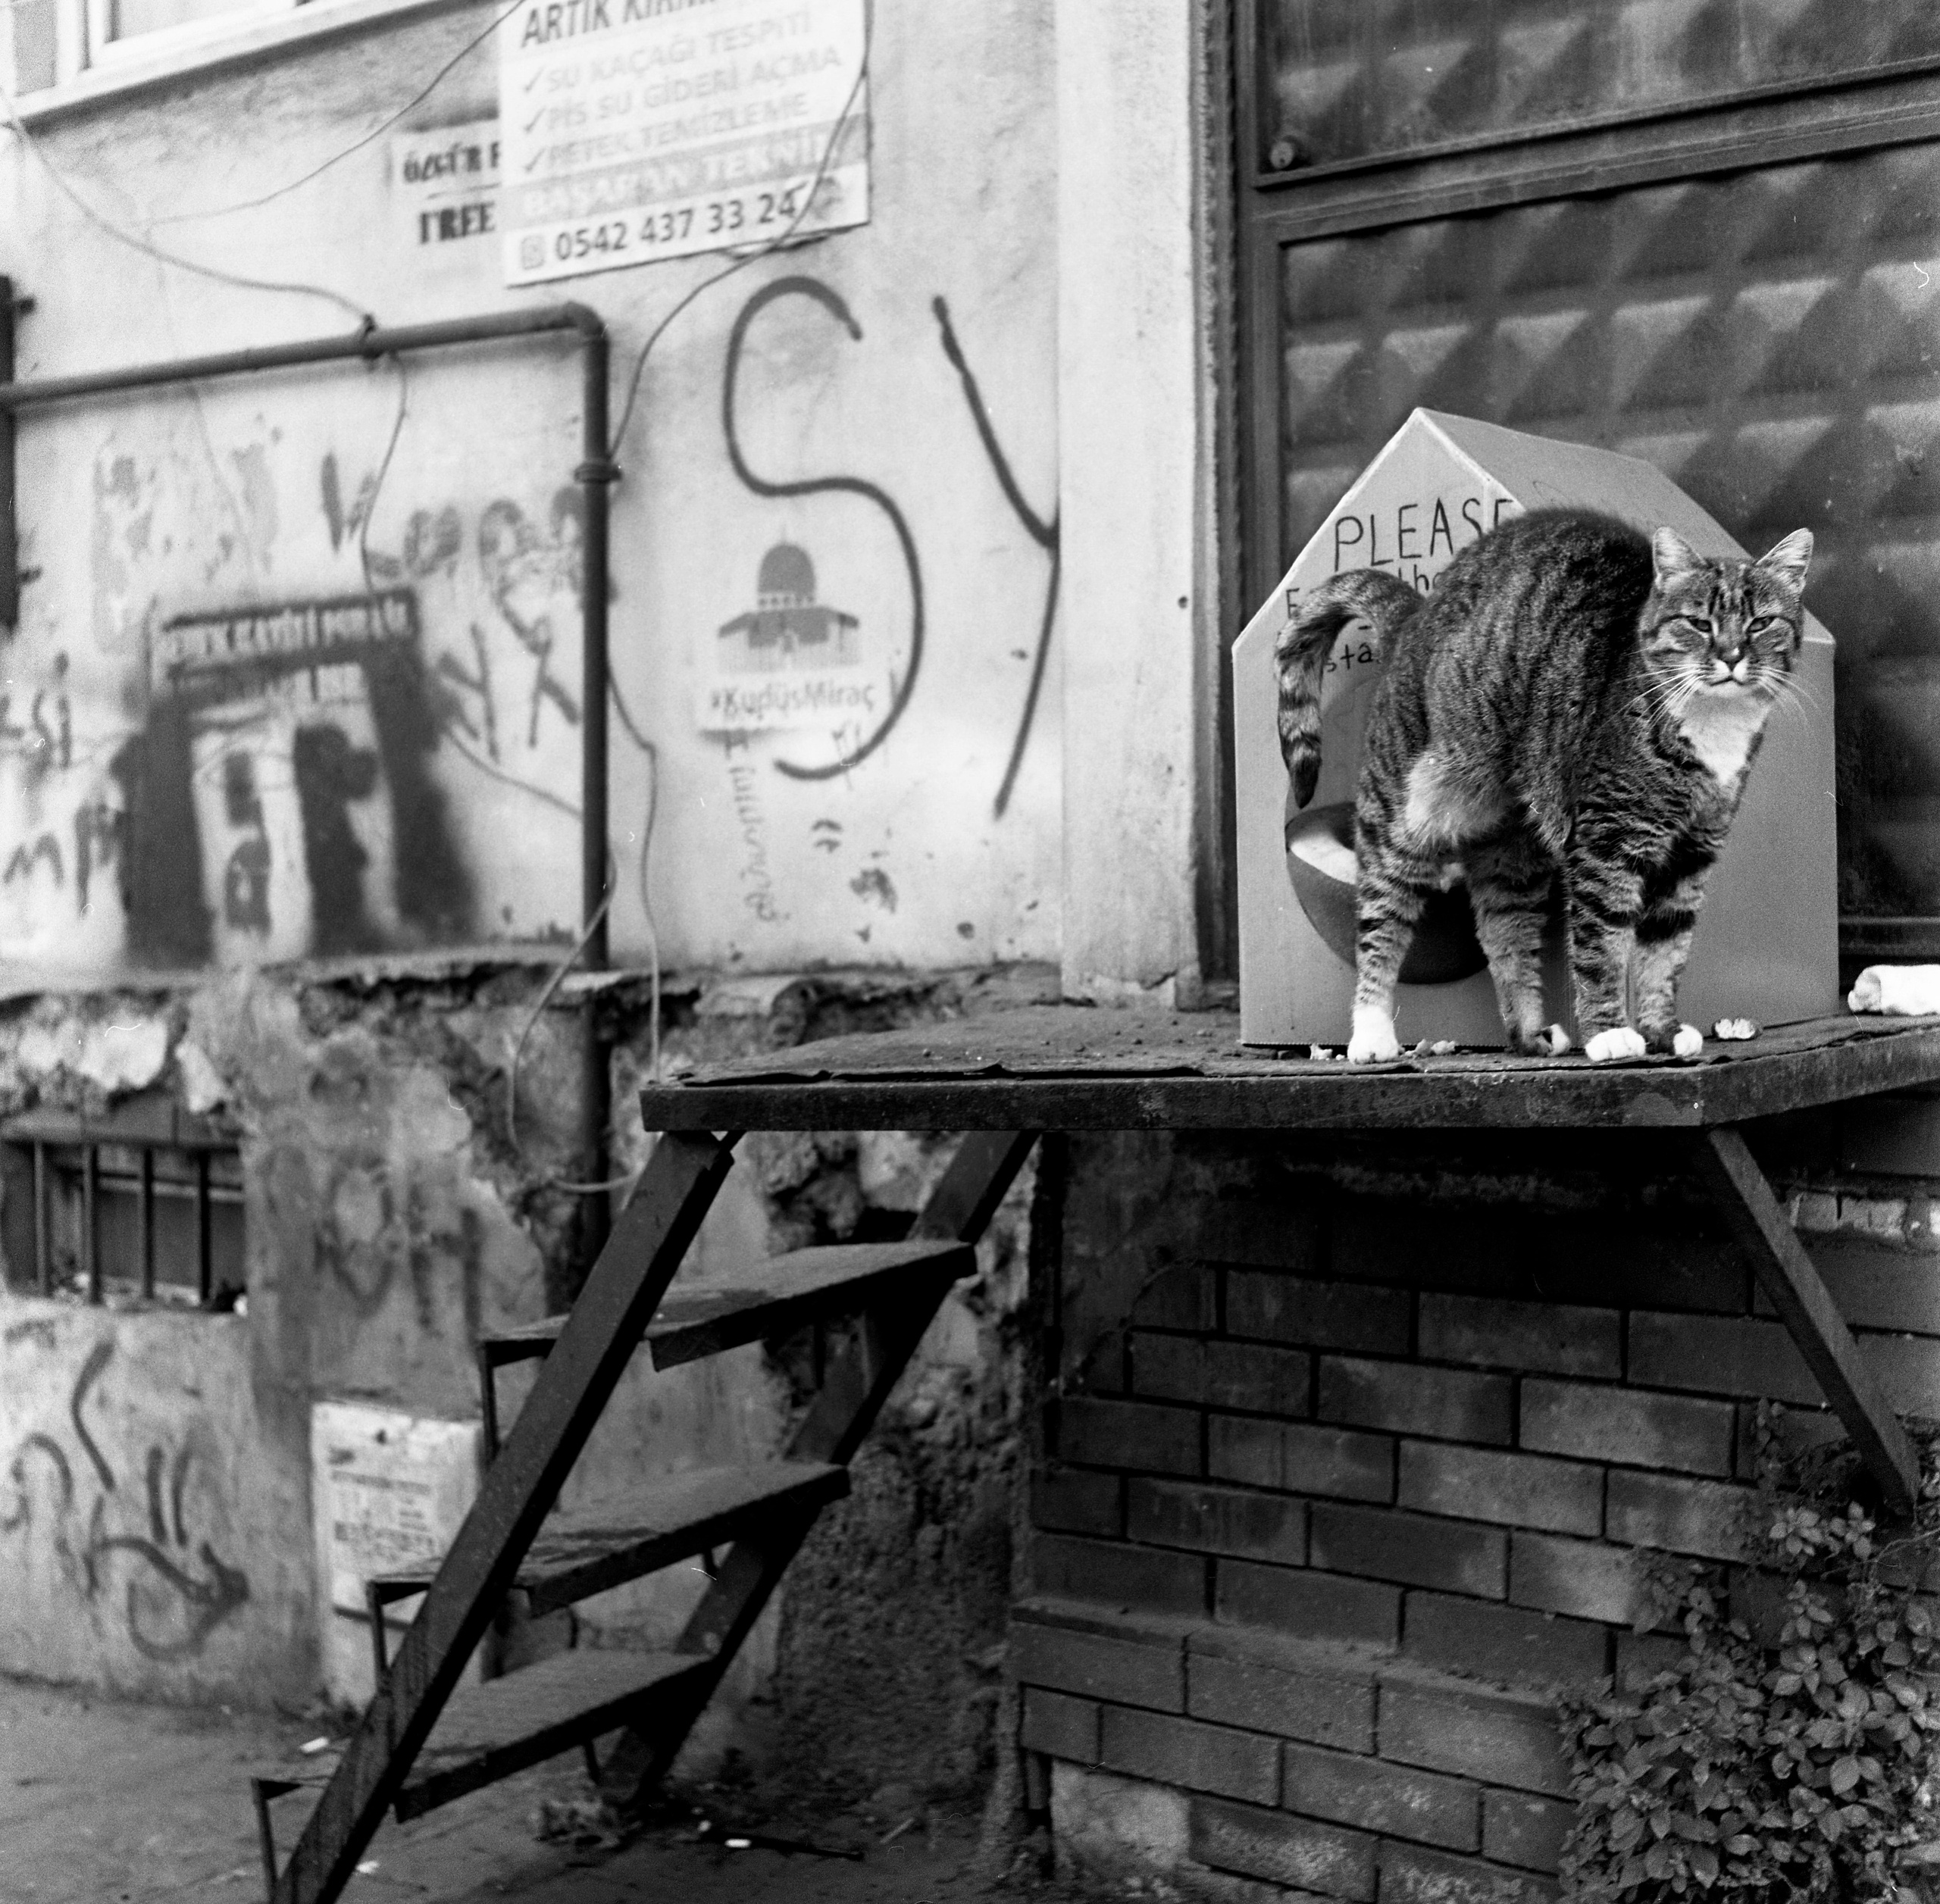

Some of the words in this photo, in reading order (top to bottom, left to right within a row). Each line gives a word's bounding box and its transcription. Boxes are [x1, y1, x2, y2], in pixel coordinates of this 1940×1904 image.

[520, 0, 612, 48] ARTIK
[546, 65, 581, 92] SU
[590, 34, 696, 80] KAÇAĞI
[706, 10, 810, 53] TESPİTİ
[547, 98, 587, 130] PİS
[597, 92, 633, 120] SU
[643, 64, 738, 108] GİDERİ
[753, 45, 842, 86] AÇMA
[548, 134, 630, 167] PETEK
[419, 202, 496, 244] FREE
[555, 223, 628, 261] 0542
[640, 208, 695, 245] 437
[707, 199, 746, 233] 33
[756, 189, 797, 224] 24
